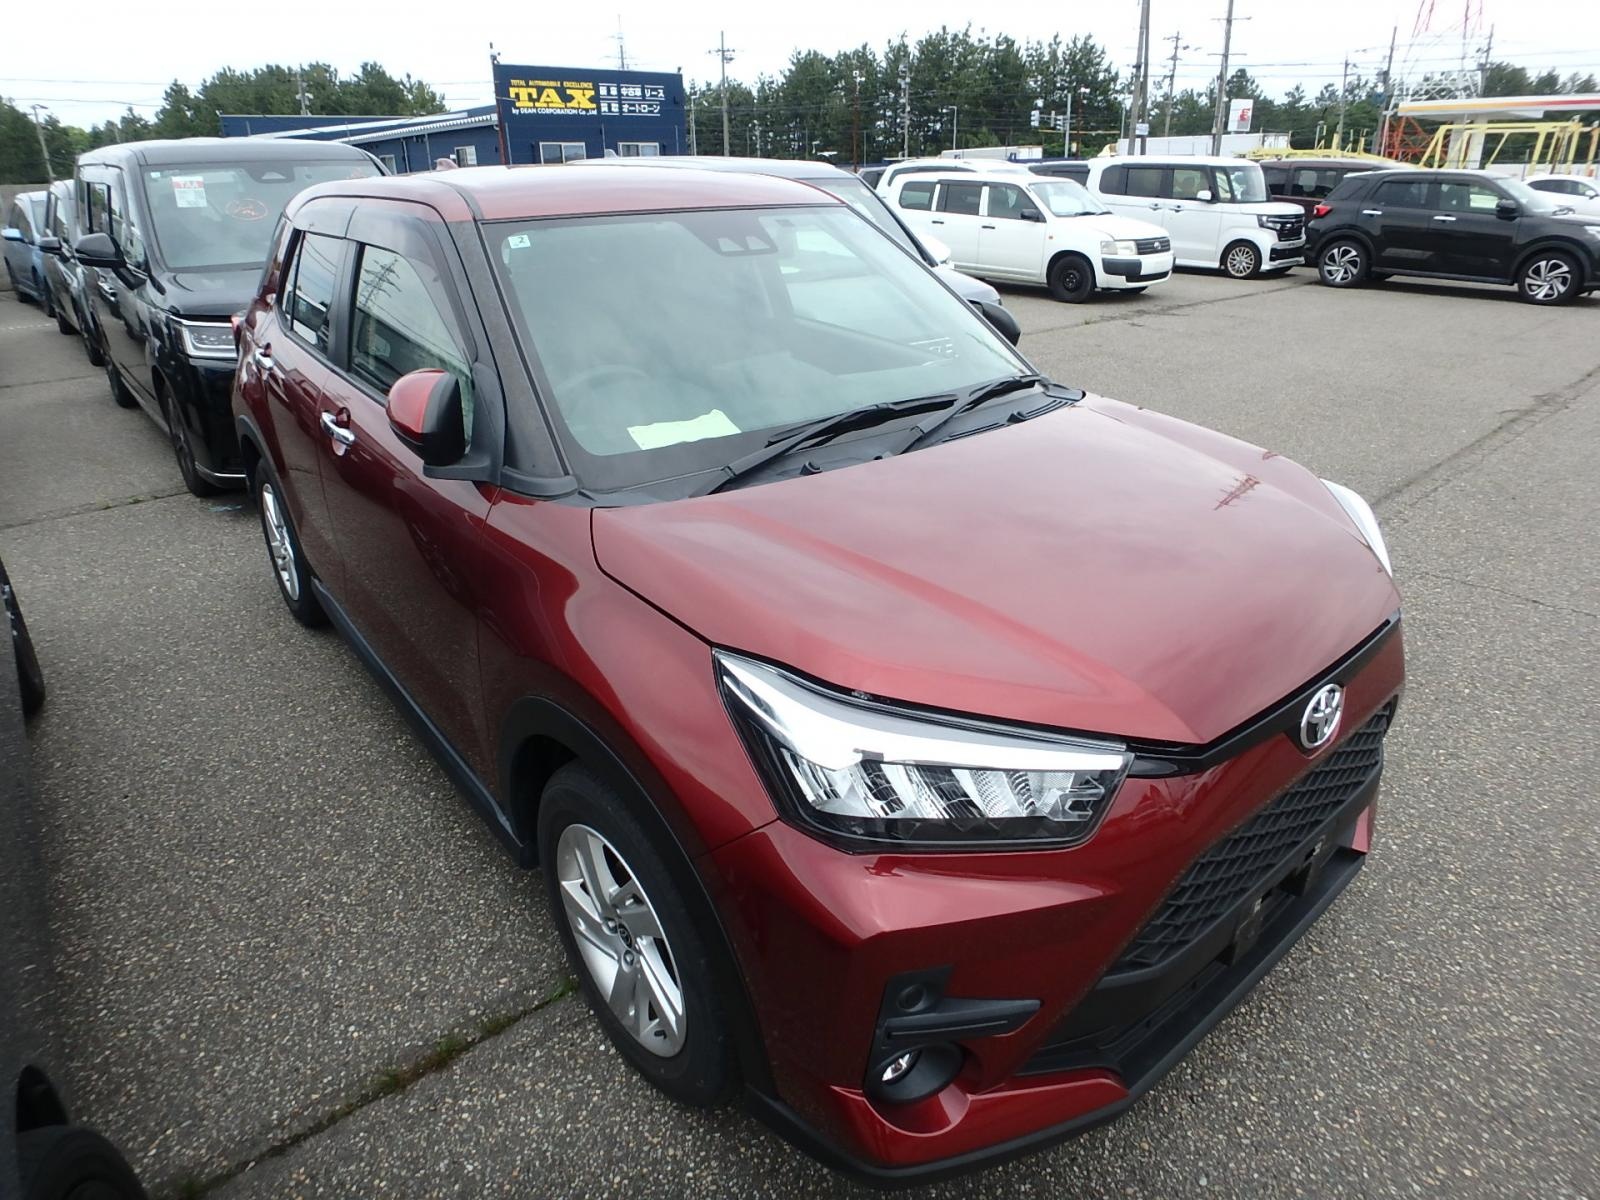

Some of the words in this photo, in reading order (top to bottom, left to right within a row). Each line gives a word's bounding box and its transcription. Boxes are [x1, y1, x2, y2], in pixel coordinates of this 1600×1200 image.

[644, 88, 665, 97] リース
[509, 87, 597, 109] TAX
[511, 107, 520, 115] by
[622, 104, 660, 113] オートローン
